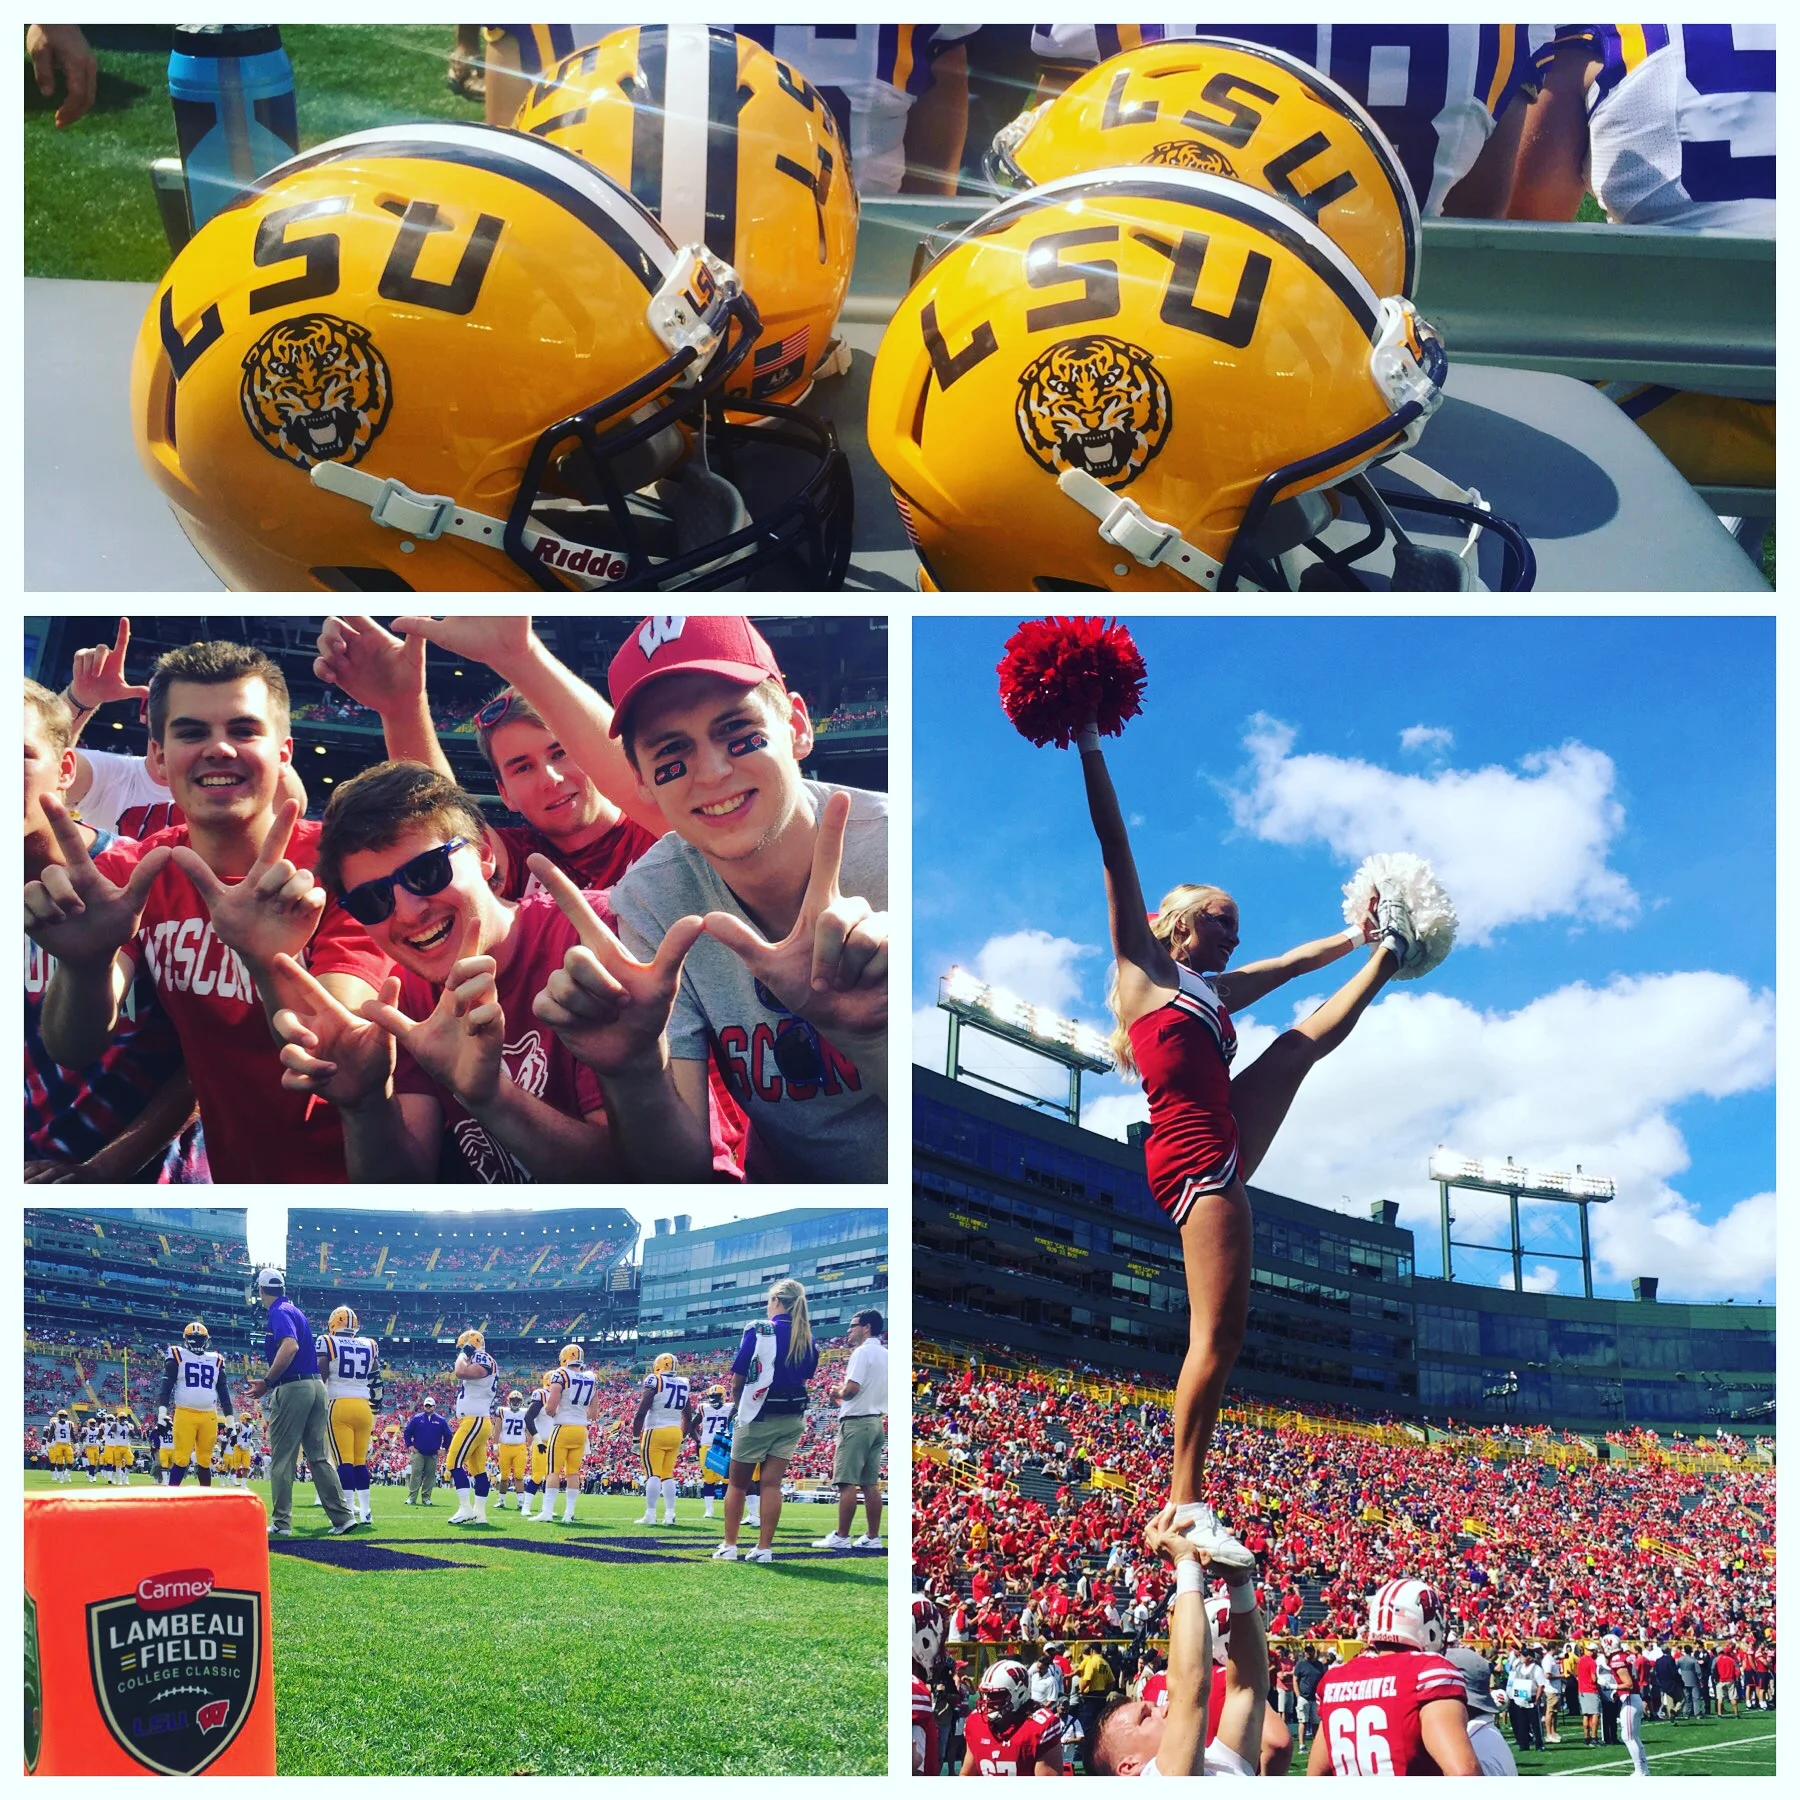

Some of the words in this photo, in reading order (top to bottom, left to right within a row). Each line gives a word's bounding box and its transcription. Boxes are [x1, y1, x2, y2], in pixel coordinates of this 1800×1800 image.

[1101, 72, 1358, 222] LSU
[160, 194, 506, 382] LSU
[678, 257, 722, 317] LS
[921, 225, 1273, 391] LSU
[339, 1345, 371, 1380] 63
[475, 1354, 488, 1364] 64
[184, 1361, 215, 1389] 68
[571, 1378, 595, 1406] 77
[663, 1382, 688, 1410] 76
[505, 1418, 524, 1436] 72
[706, 1416, 728, 1434] 73
[138, 1576, 213, 1600] Carmex
[109, 1613, 244, 1650] LAMBEAU
[141, 1639, 217, 1669] FIELD
[117, 1667, 180, 1693] COLLEGE
[185, 1666, 241, 1679] CLASSIC
[132, 1710, 188, 1738] LSU
[1328, 1704, 1396, 1776] 66
